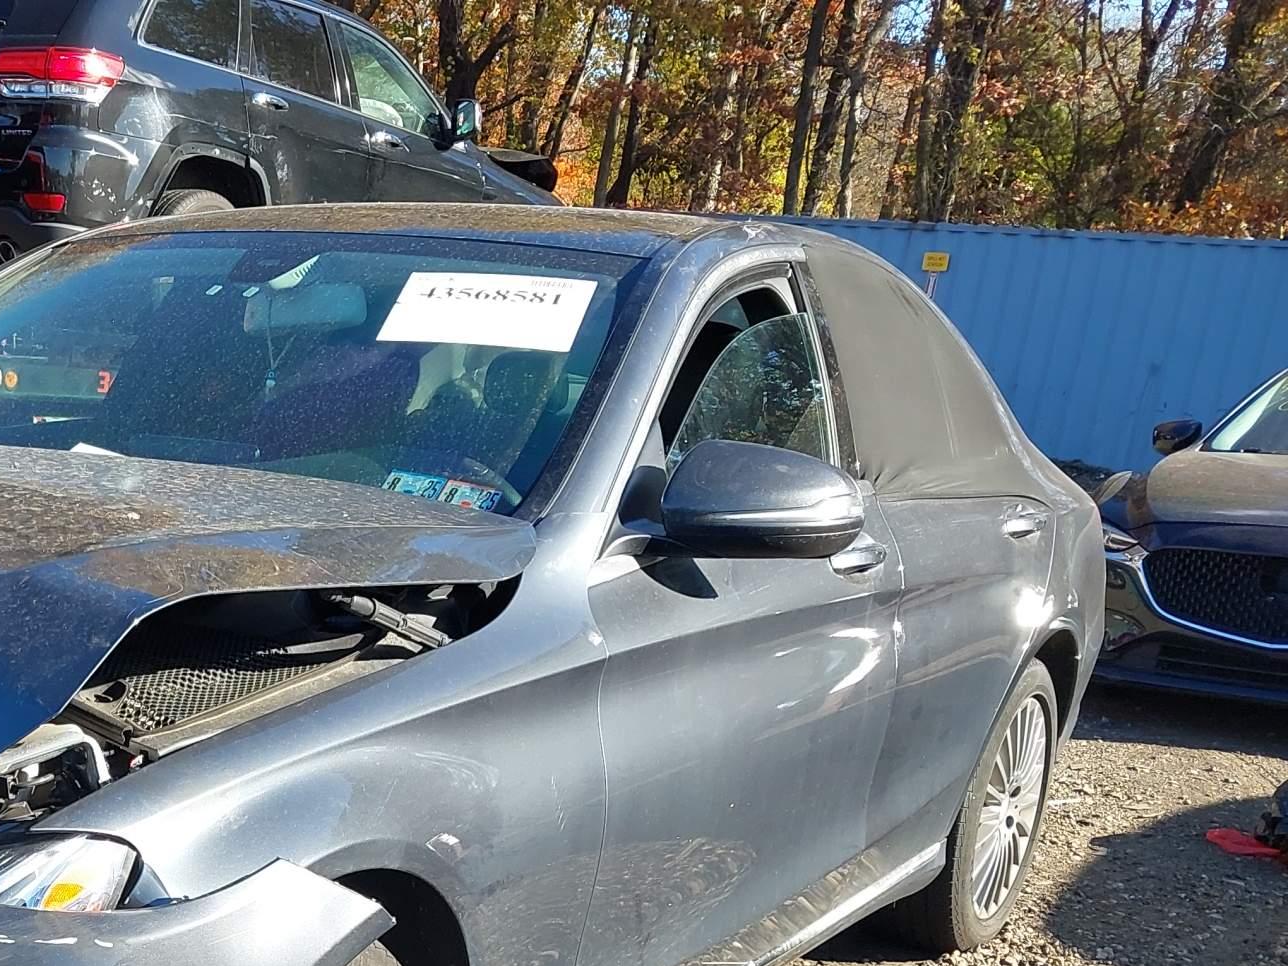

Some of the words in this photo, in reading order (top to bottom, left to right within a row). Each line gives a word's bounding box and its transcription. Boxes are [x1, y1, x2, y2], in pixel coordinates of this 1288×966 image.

[419, 286, 562, 305] 43568581
[390, 477, 402, 491] 8
[420, 480, 442, 499] 25
[445, 487, 459, 503] 8
[479, 490, 500, 511] 25
